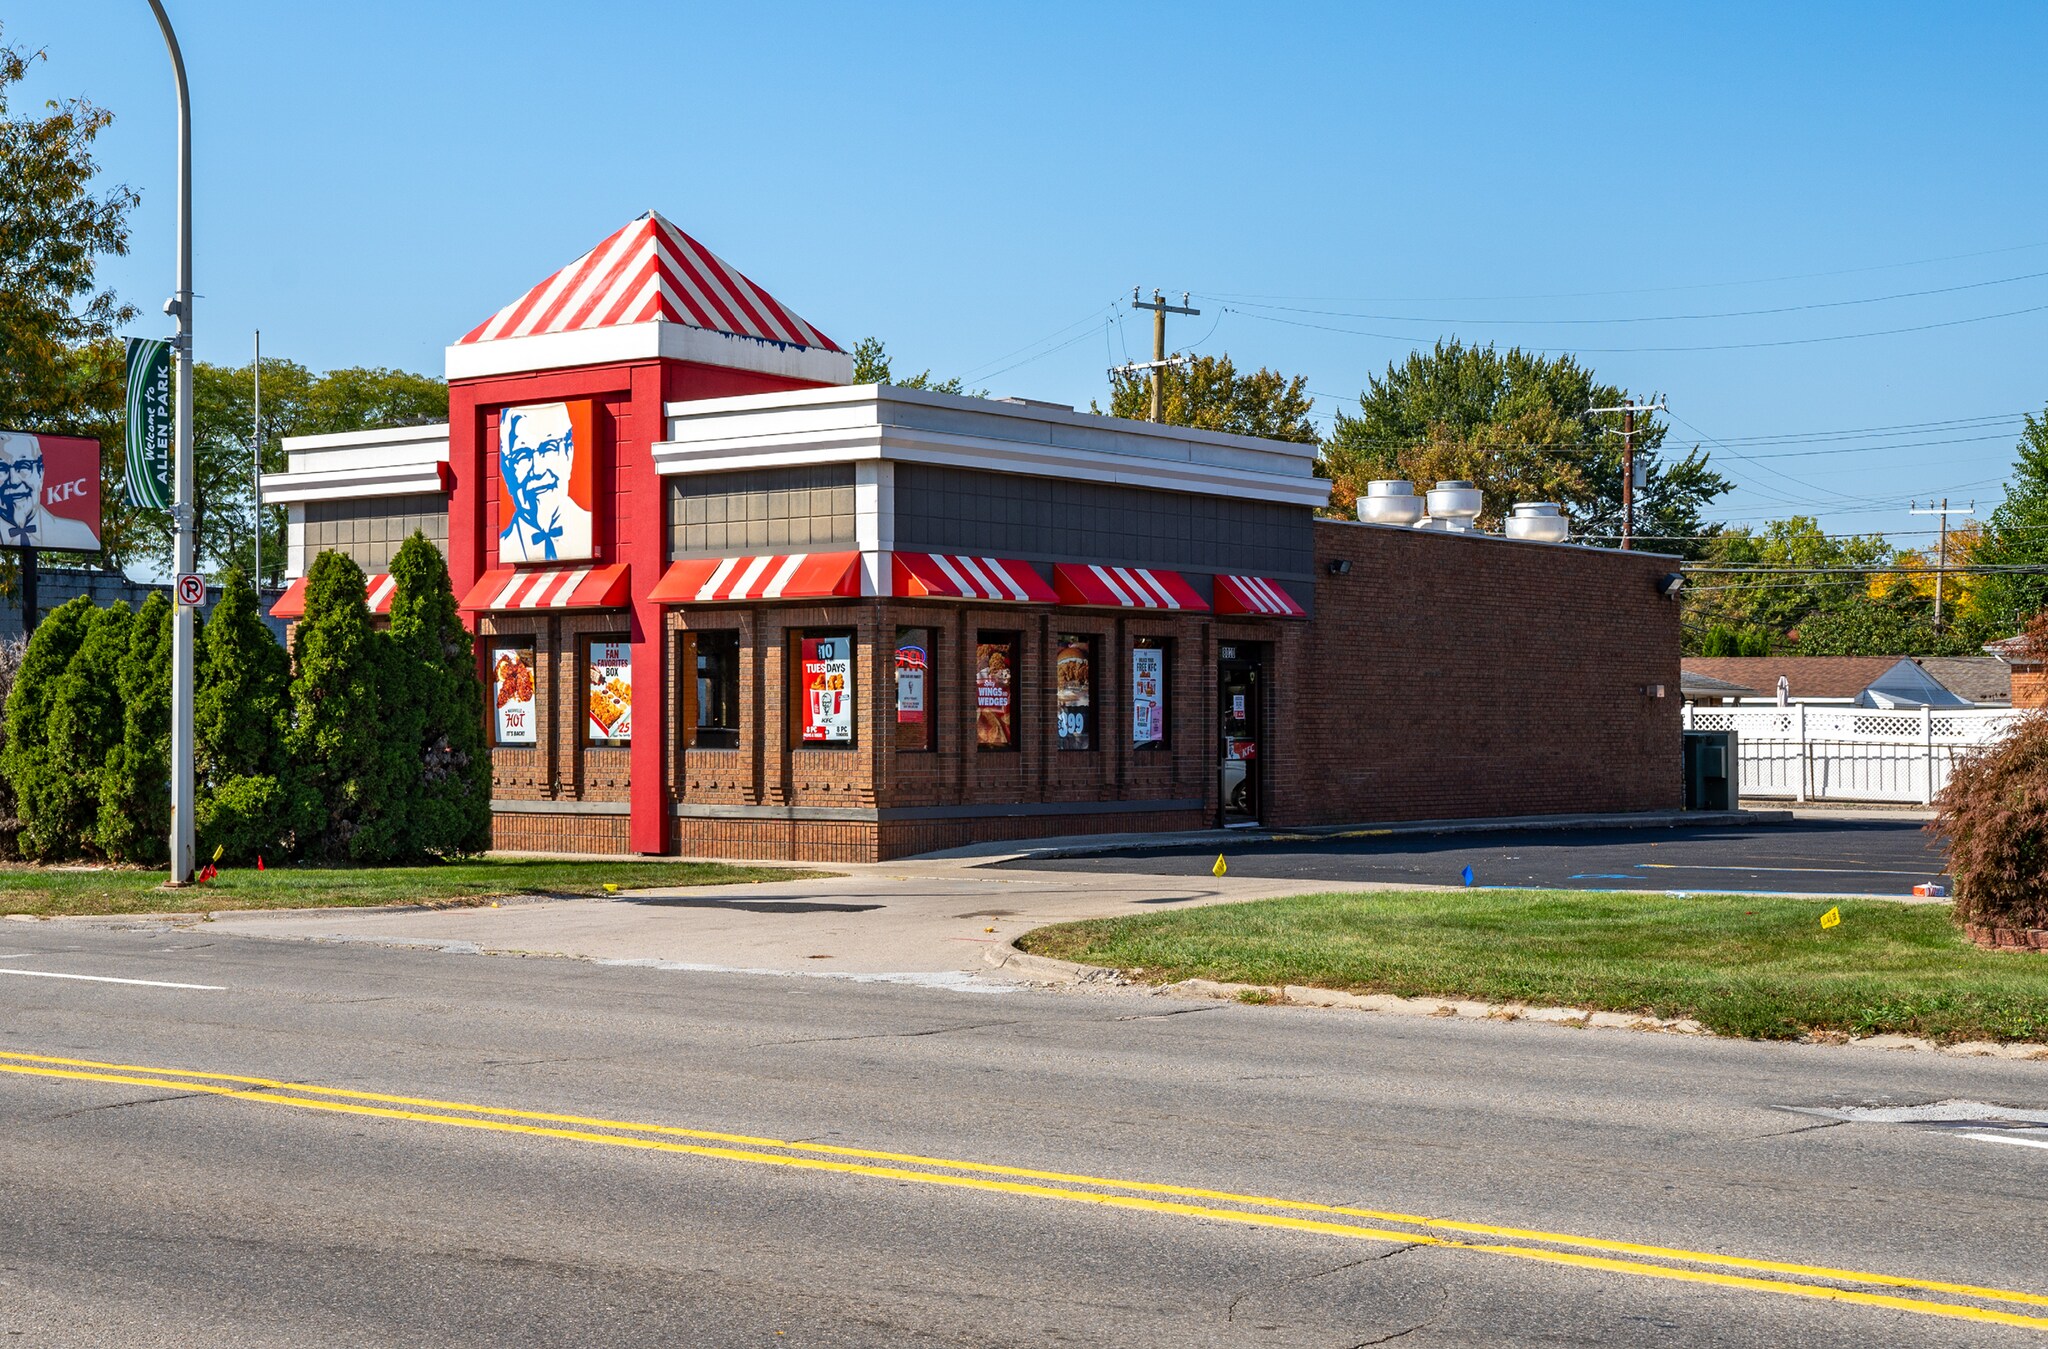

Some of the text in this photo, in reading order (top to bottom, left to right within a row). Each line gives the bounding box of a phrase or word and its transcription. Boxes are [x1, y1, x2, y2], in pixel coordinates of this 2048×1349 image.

[144, 386, 156, 461] Welcome to
[157, 365, 169, 485] ALLEN PARK
[46, 478, 88, 506] KFC
[186, 580, 199, 599] P
[606, 649, 619, 659] FAN
[597, 659, 629, 667] FAVORITES
[806, 663, 846, 673] TUESDAYS
[1136, 662, 1157, 672] FREE KFC
[606, 667, 619, 677] BOX
[978, 687, 1003, 697] WINGS
[977, 697, 1008, 706] WEDGES
[505, 713, 526, 729] HOT
[840, 725, 848, 733] PC
[1242, 743, 1255, 758] KFC
